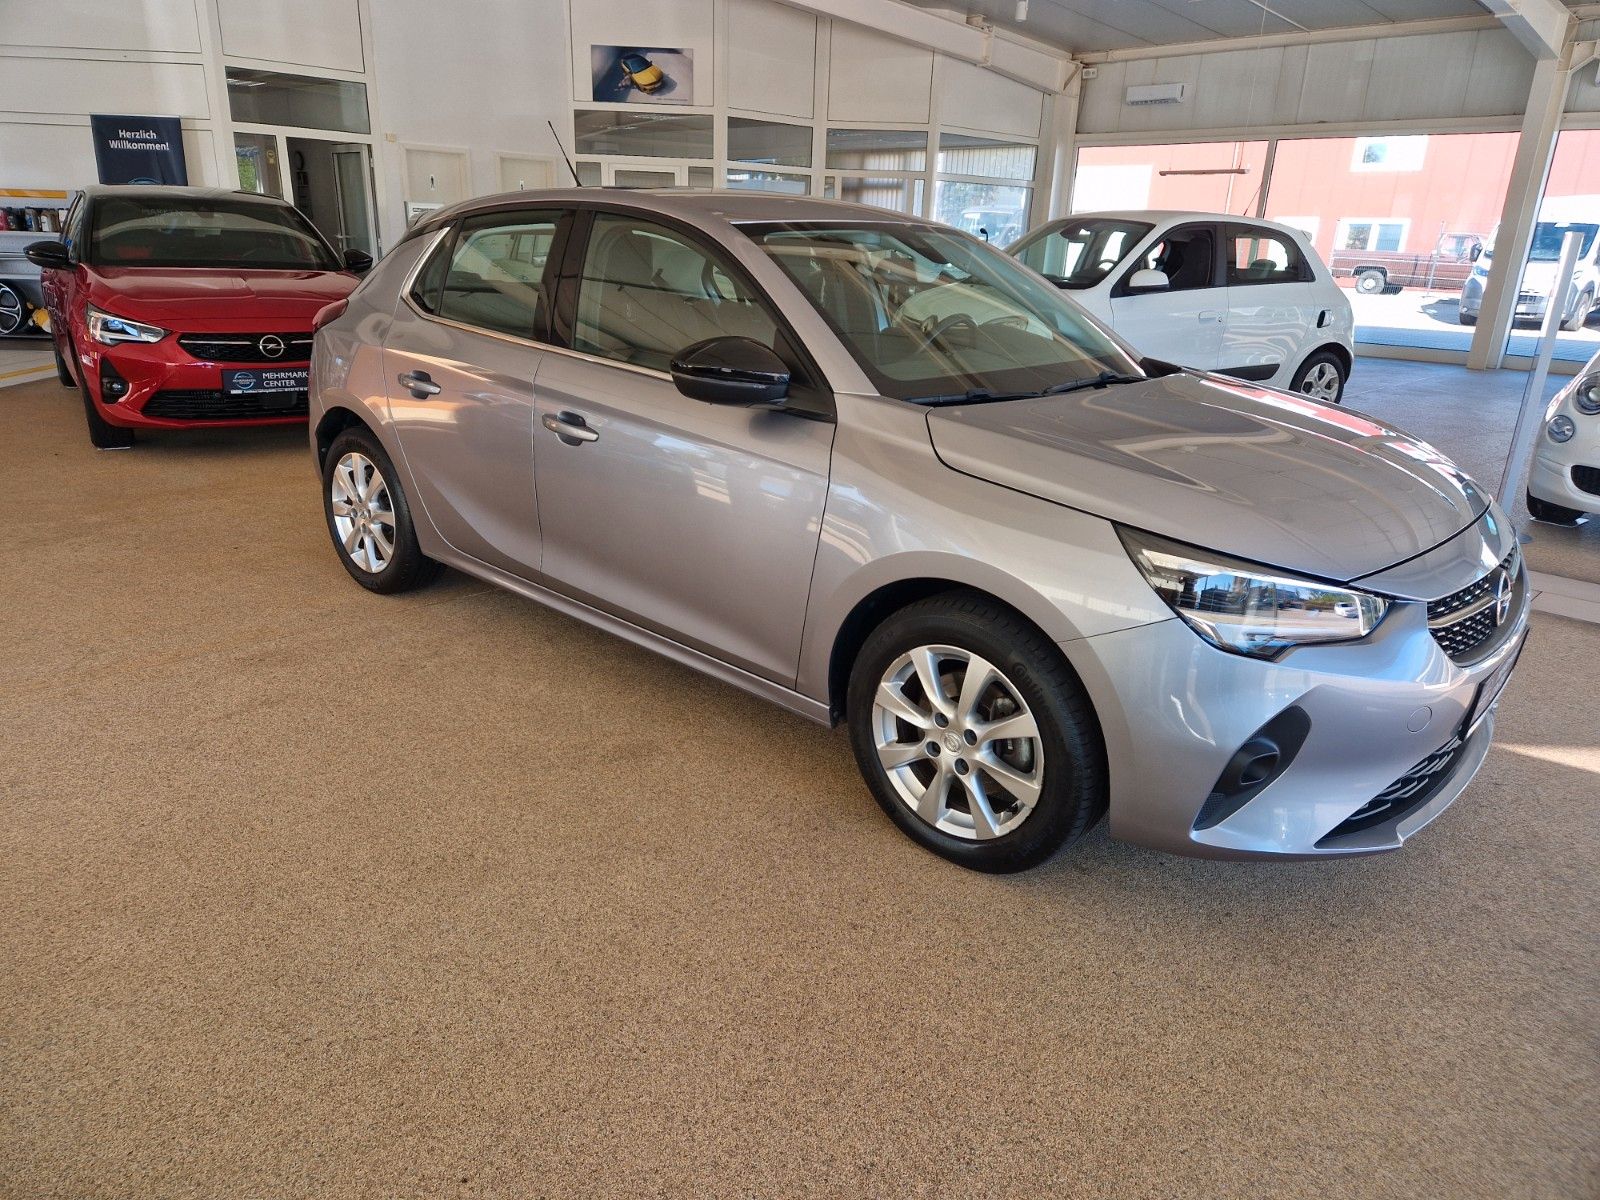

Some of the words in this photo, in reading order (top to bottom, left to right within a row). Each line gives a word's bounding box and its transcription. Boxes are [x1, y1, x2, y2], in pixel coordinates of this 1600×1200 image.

[118, 129, 157, 139] Herzlich
[108, 140, 170, 151] Willkommen!
[262, 371, 309, 379] MEHRMARK
[263, 379, 296, 388] CENTER
